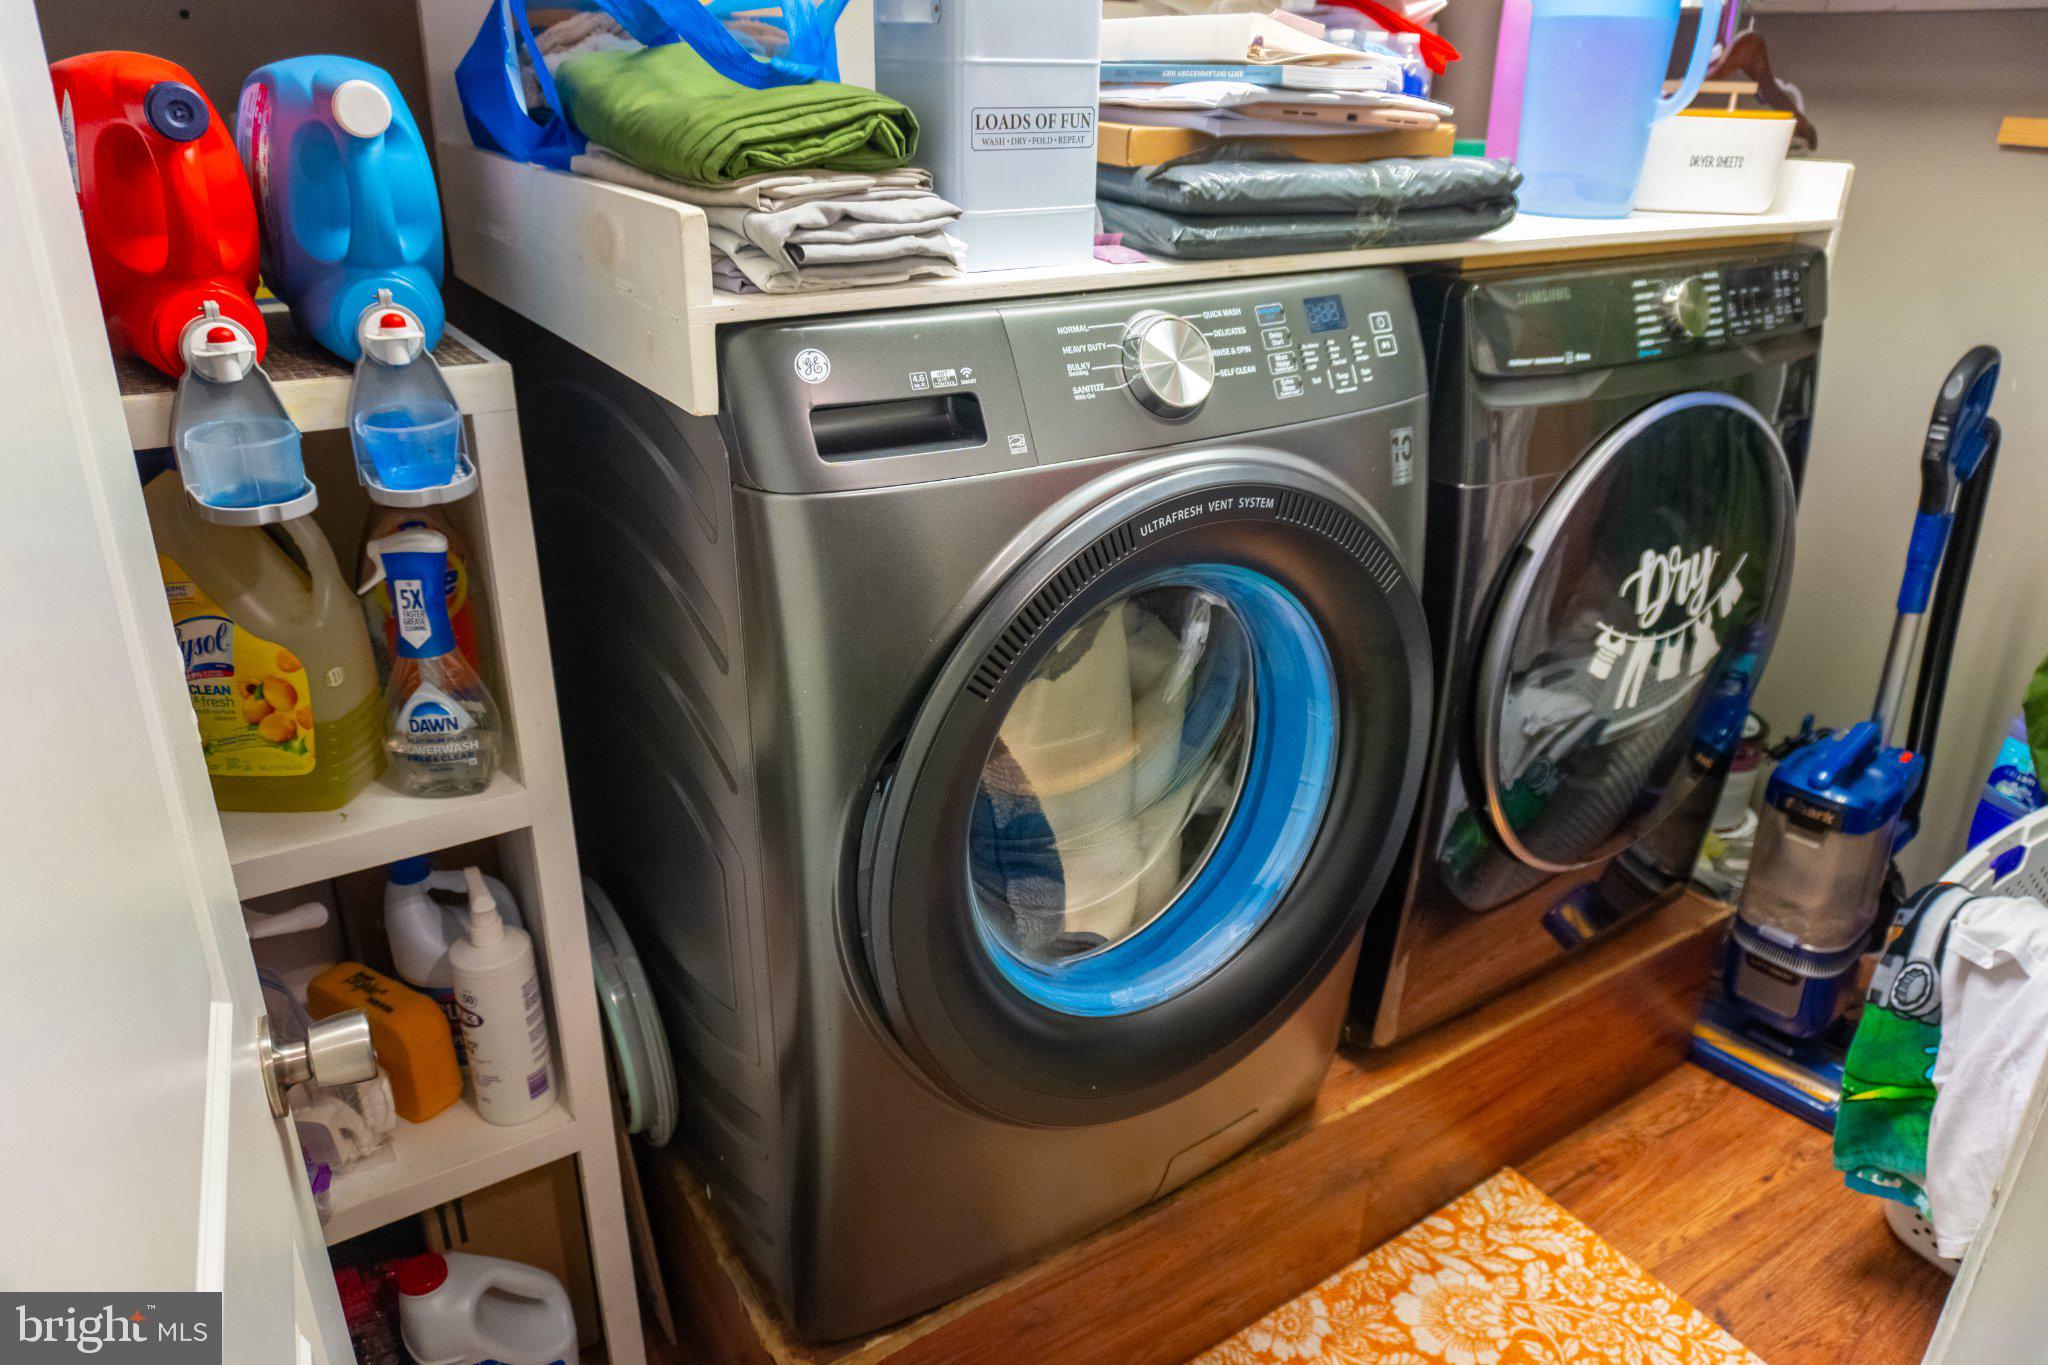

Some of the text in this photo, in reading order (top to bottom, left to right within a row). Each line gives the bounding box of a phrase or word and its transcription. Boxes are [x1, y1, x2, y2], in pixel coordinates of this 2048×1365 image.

[976, 113, 1091, 130] LOADS OF FUN
[982, 136, 1085, 146] WASH DRY FOLD REPEAT
[1690, 155, 1744, 168] DRYER SHEETS
[1203, 308, 1241, 319] QUICK WASH
[1057, 325, 1089, 334] NORMAL
[1213, 327, 1246, 337] DELICATES
[1062, 343, 1106, 354] HEAVY DUTY
[1237, 346, 1251, 354] SPIN
[1067, 362, 1090, 371] BULKY
[1220, 366, 1256, 377] SELF CLEAN
[1072, 383, 1104, 394] SANITIZE
[1140, 497, 1275, 537] ULTRAFRESH VENT SYSTEM
[1619, 544, 1720, 629] Dry
[400, 589, 424, 609] 5X
[188, 684, 232, 695] CLEAN
[201, 696, 235, 708] fresh
[409, 717, 459, 733] DAWN
[400, 740, 480, 754] POWERWASH
